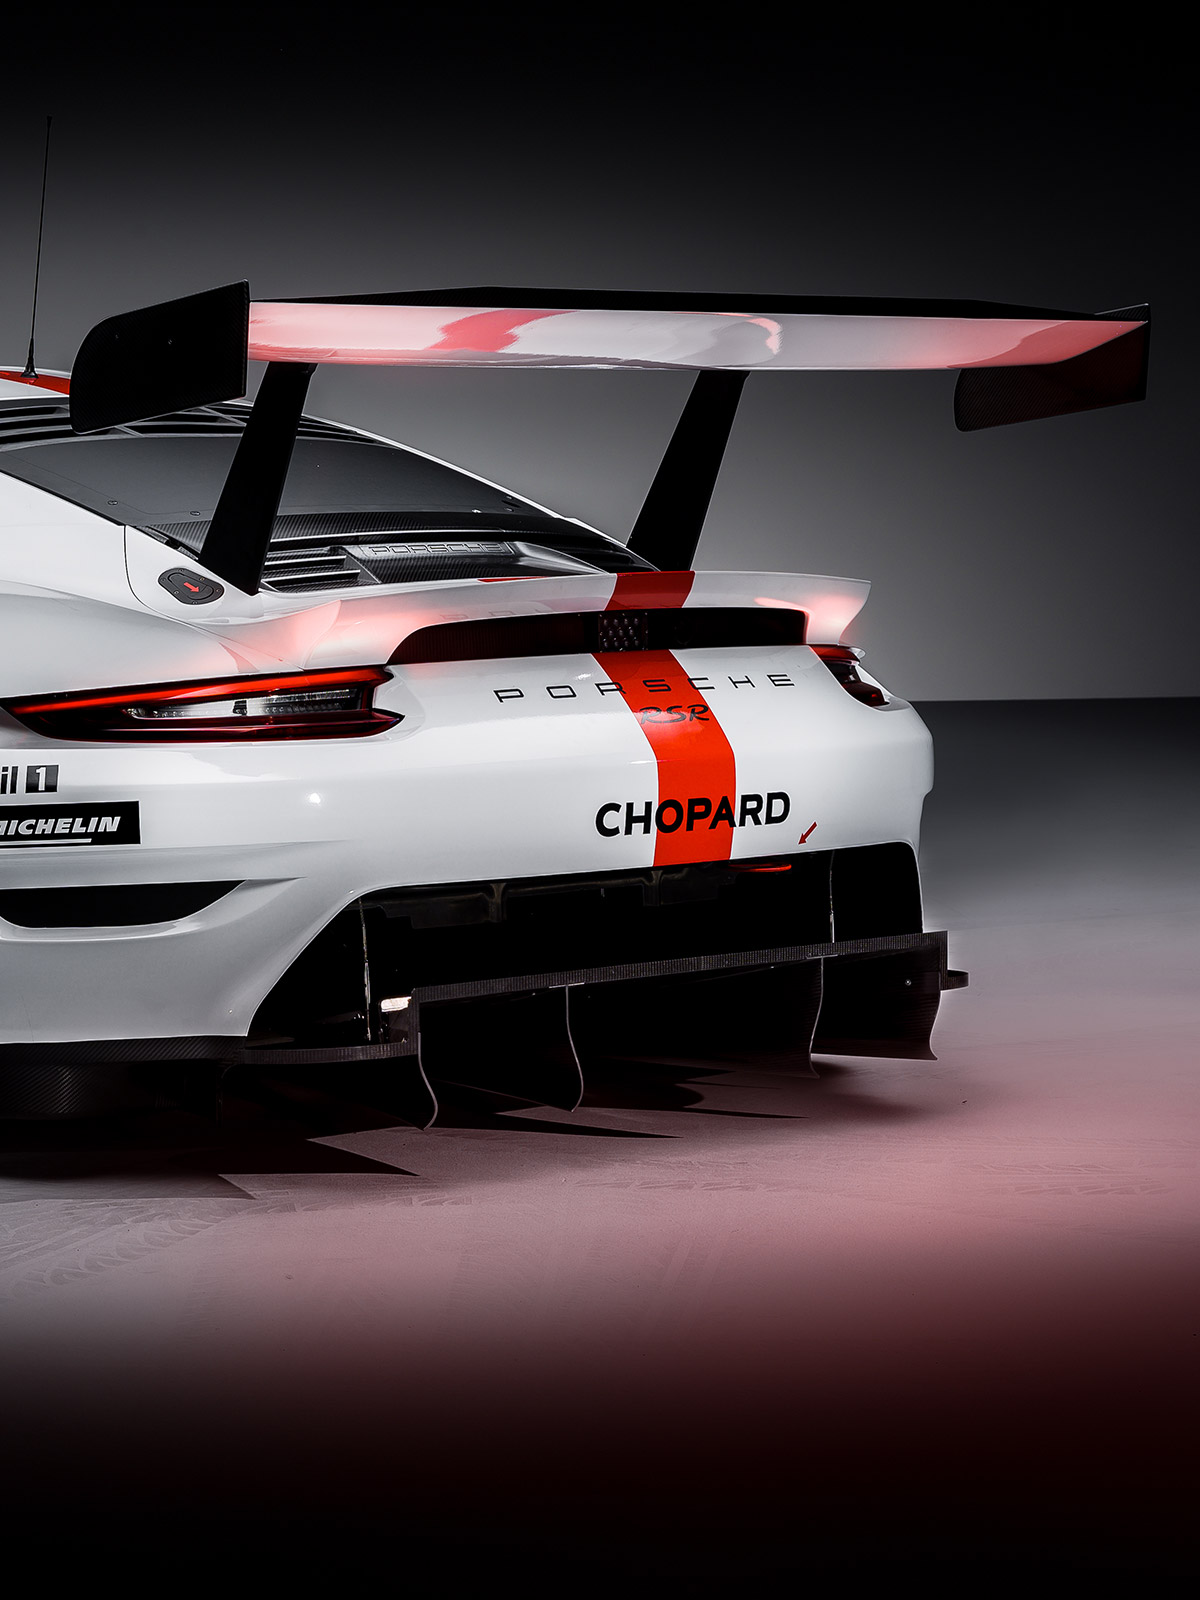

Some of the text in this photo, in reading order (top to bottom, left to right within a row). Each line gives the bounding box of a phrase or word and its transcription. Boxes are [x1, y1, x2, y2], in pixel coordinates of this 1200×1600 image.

[368, 541, 505, 556] PORSCHE
[493, 673, 795, 704] PORSCHE
[640, 703, 710, 725] RSR
[595, 791, 791, 837] CHOPARD
